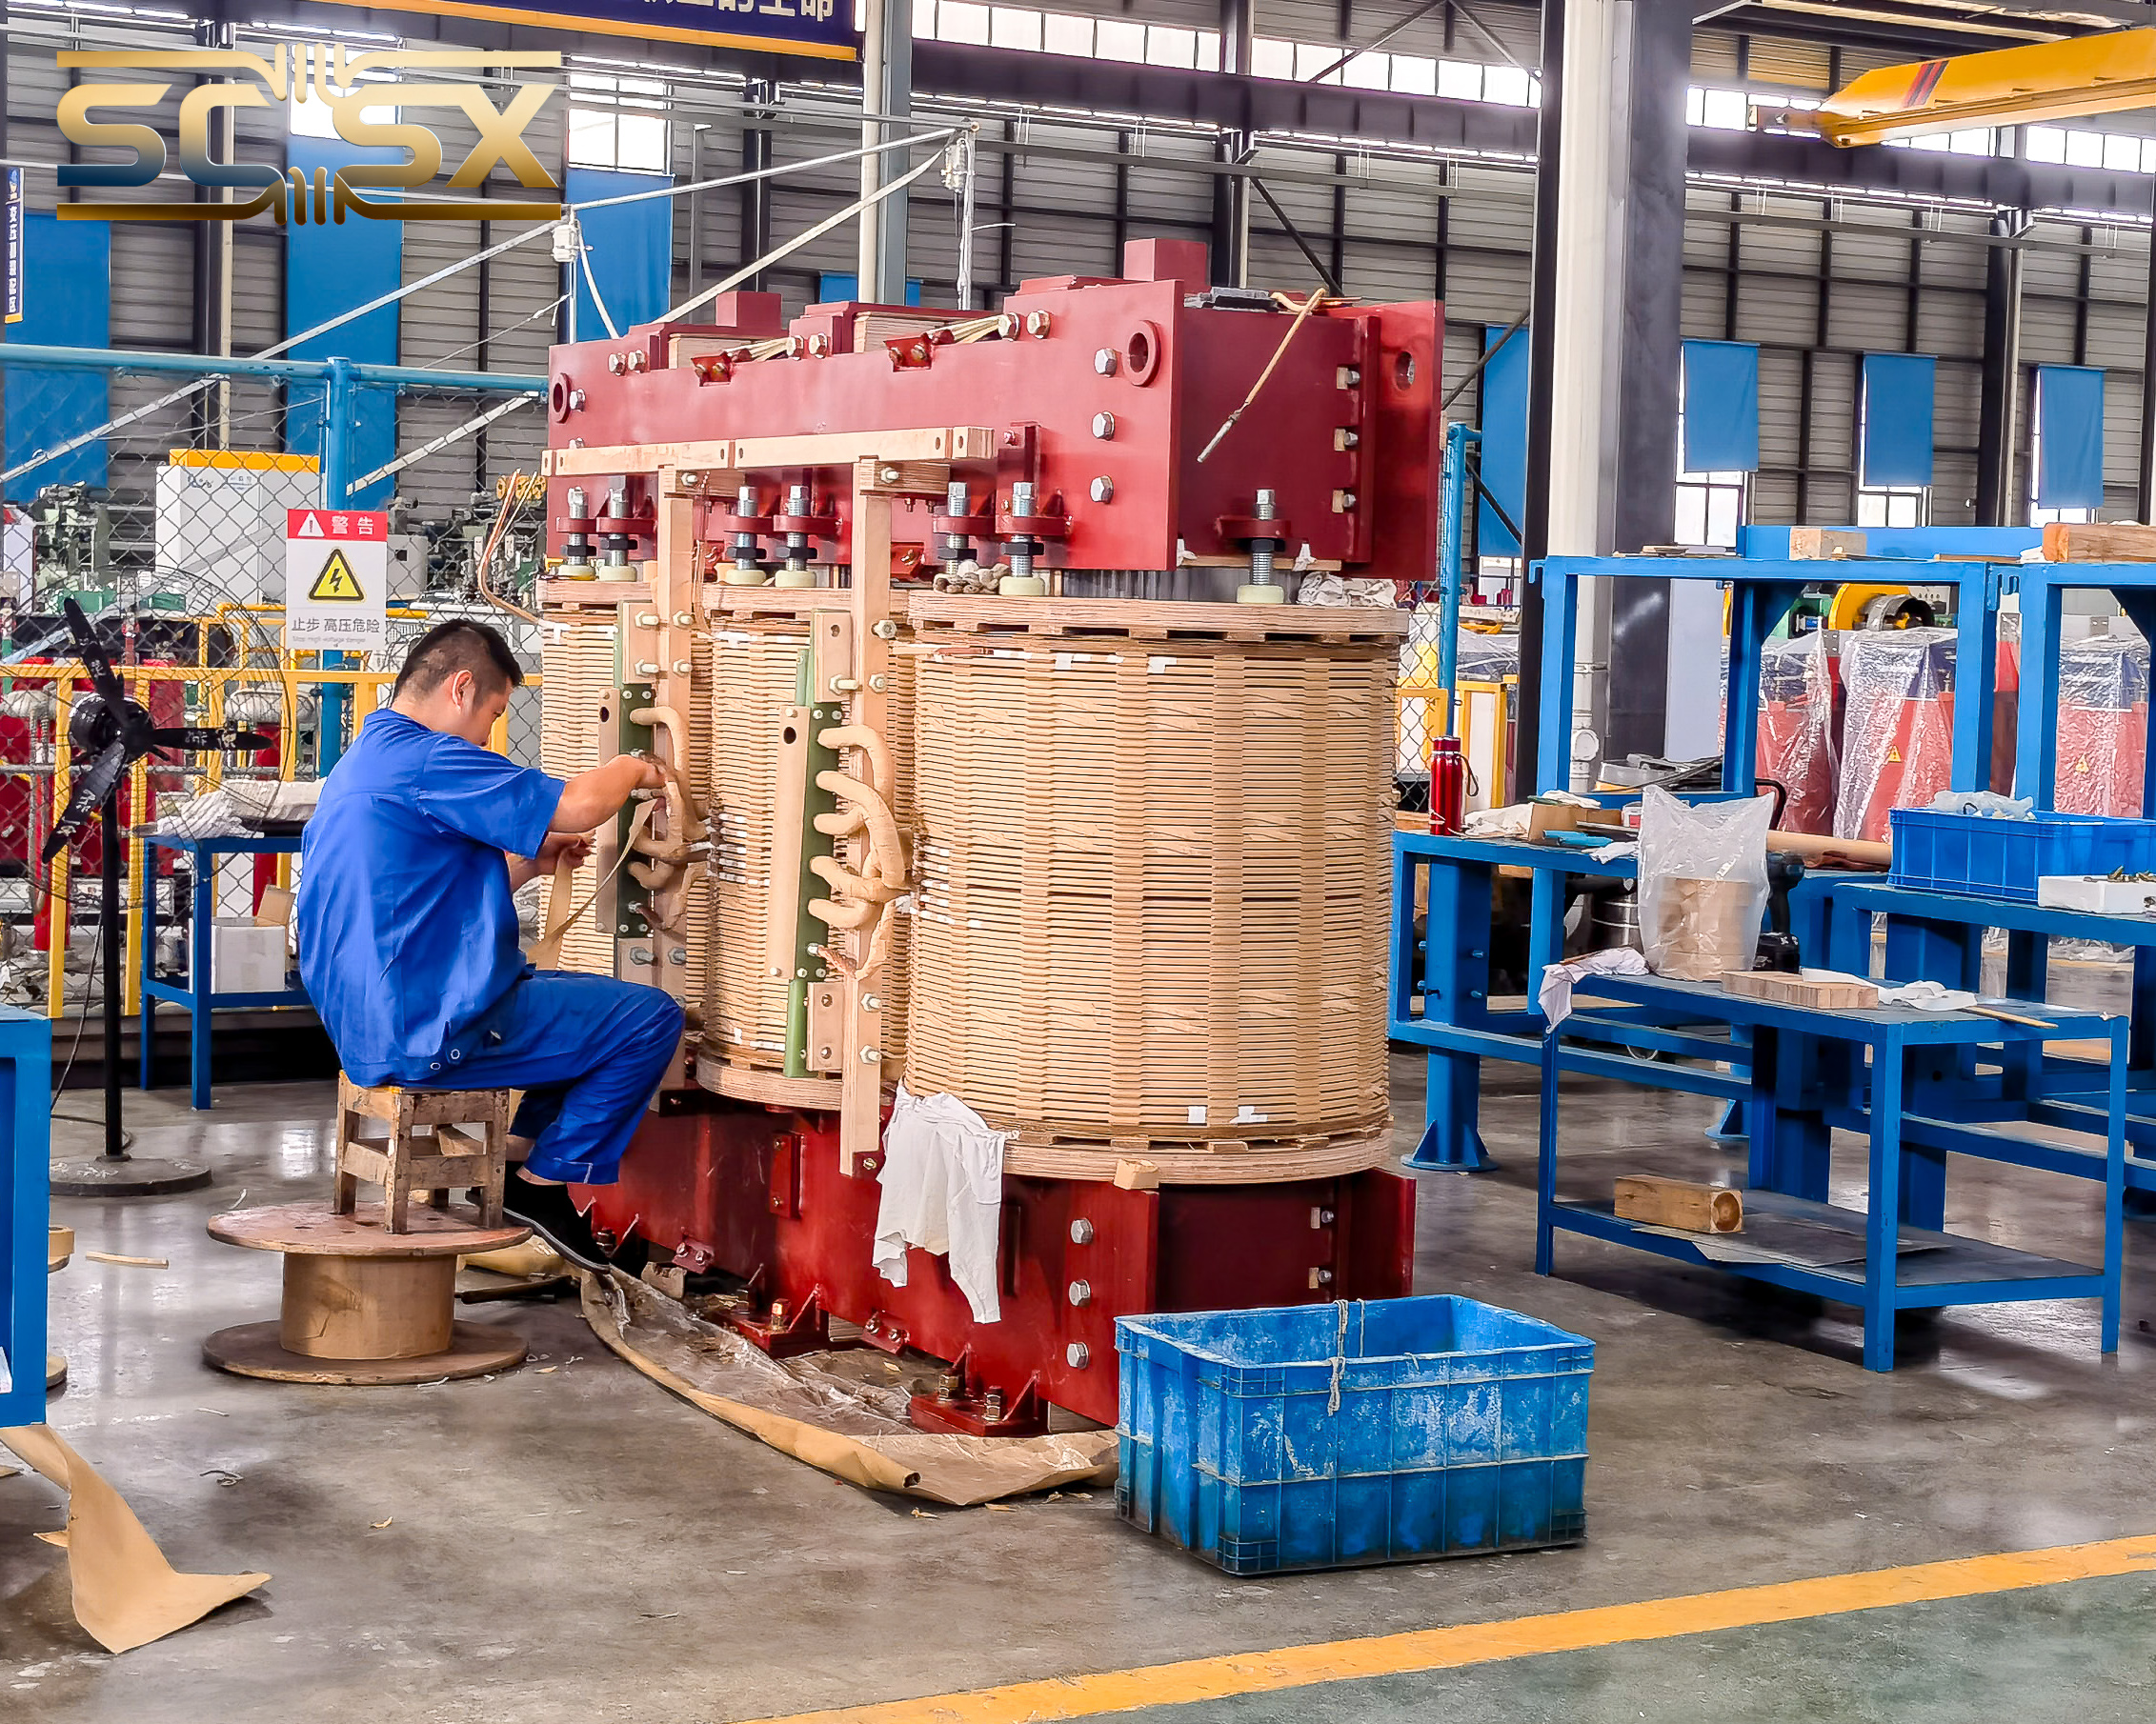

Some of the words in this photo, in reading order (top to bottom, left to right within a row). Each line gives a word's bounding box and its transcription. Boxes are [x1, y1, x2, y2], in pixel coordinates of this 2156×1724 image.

[331, 515, 373, 535] 警告
[292, 617, 320, 632] 止步
[324, 617, 380, 632] 高压危险
